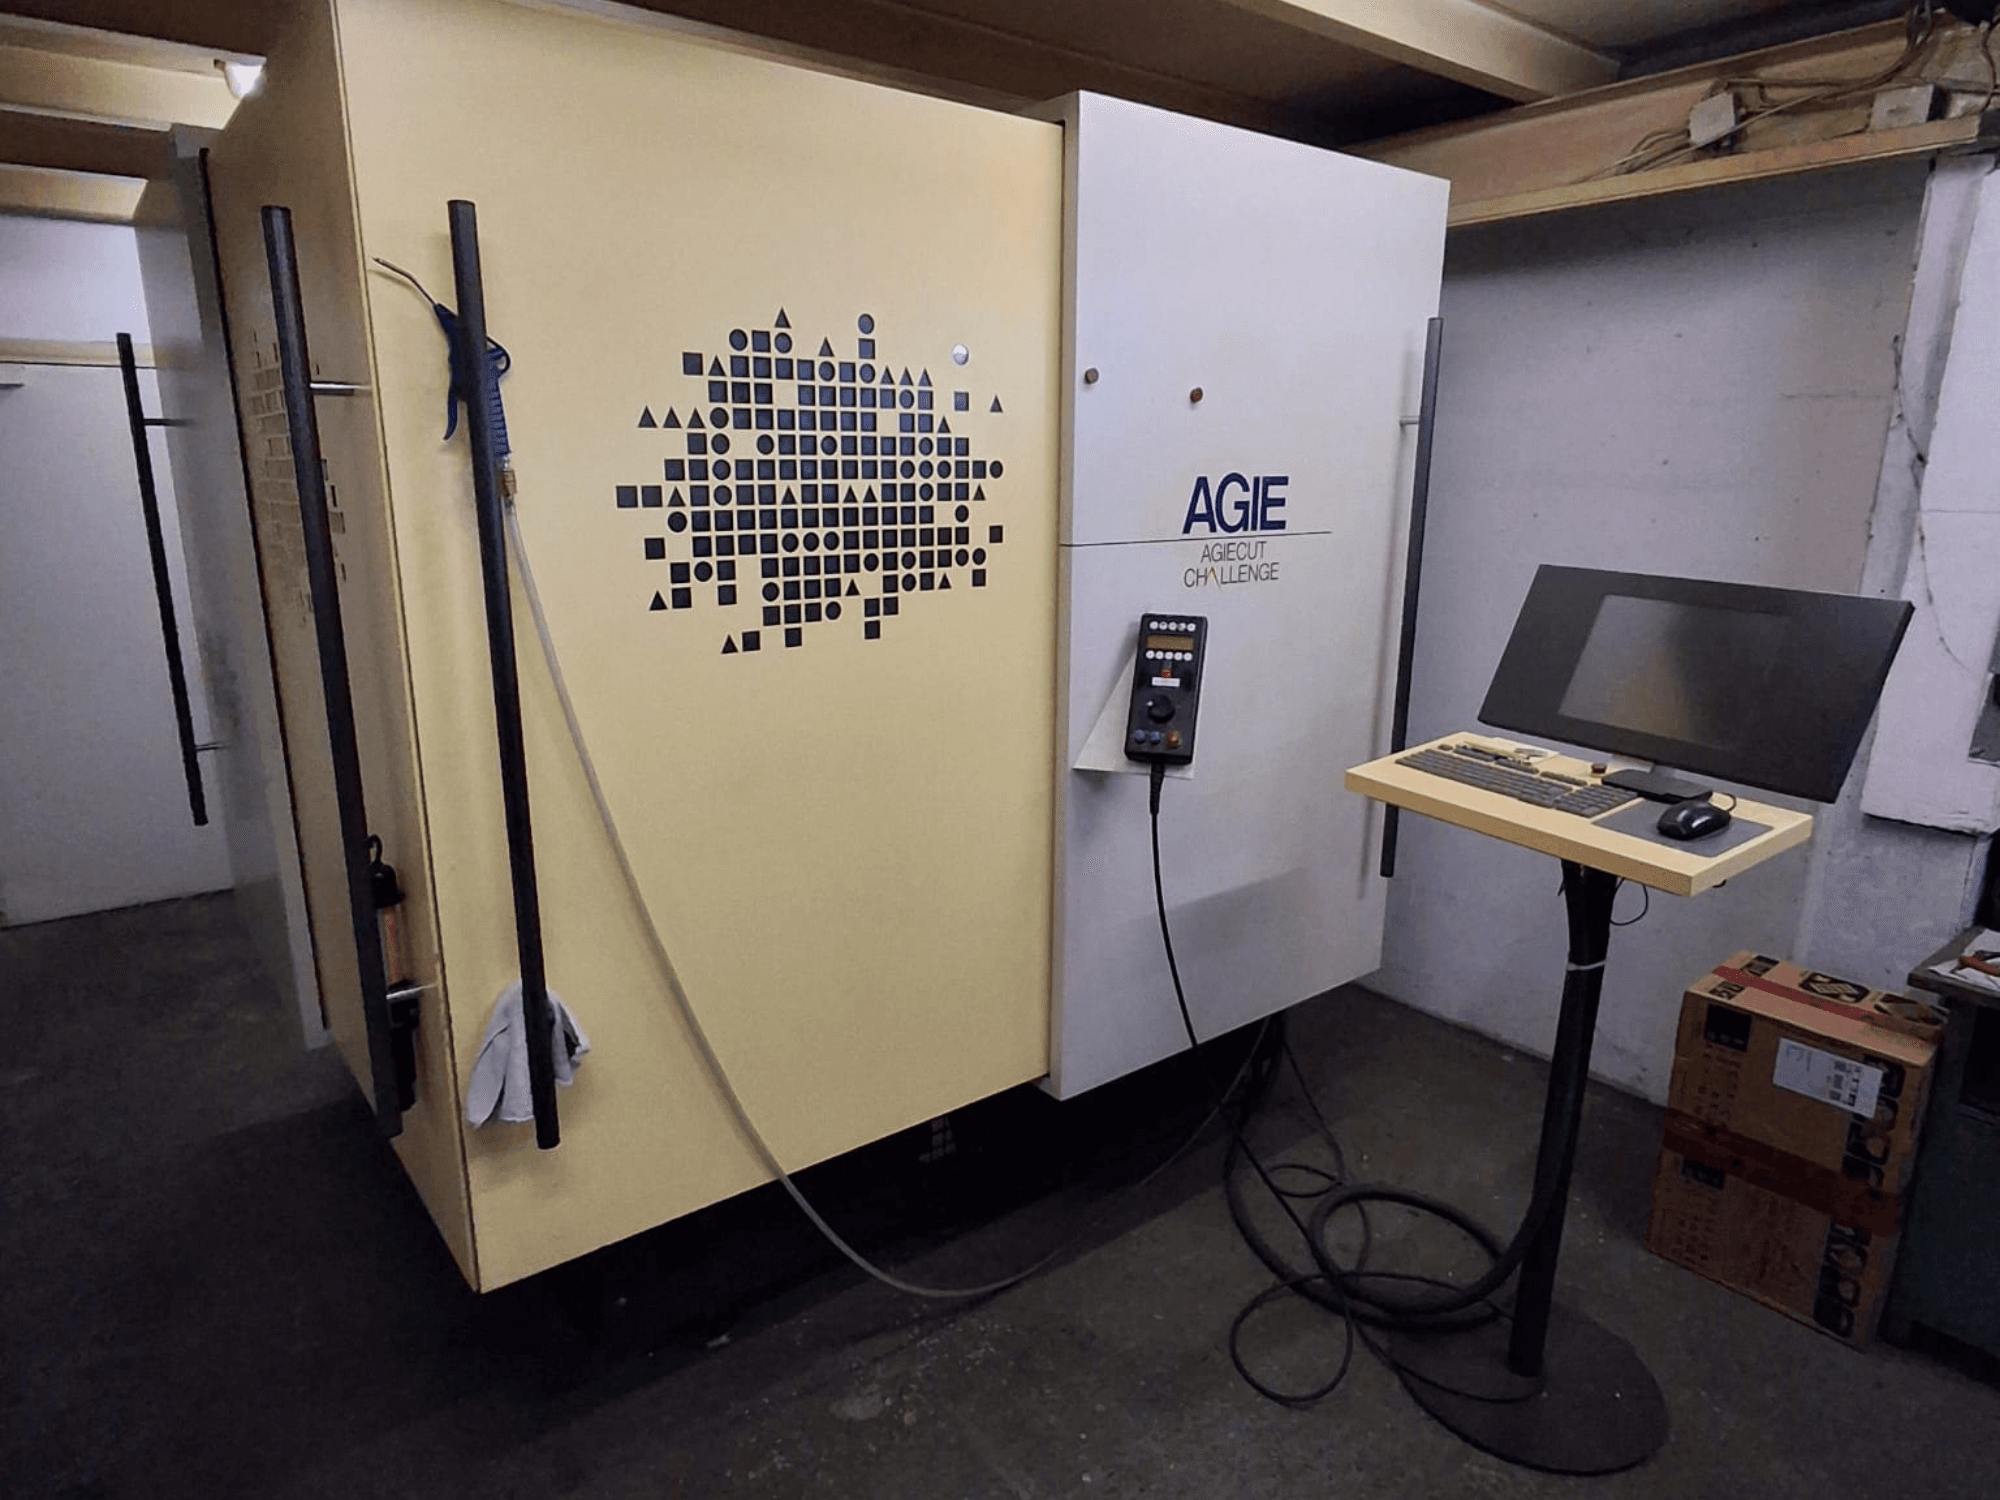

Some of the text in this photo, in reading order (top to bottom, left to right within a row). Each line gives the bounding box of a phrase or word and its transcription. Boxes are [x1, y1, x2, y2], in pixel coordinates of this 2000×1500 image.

[1182, 472, 1289, 535] AGIE
[1200, 541, 1268, 563] AGIECUT
[1183, 562, 1280, 589] CHALLENGE
